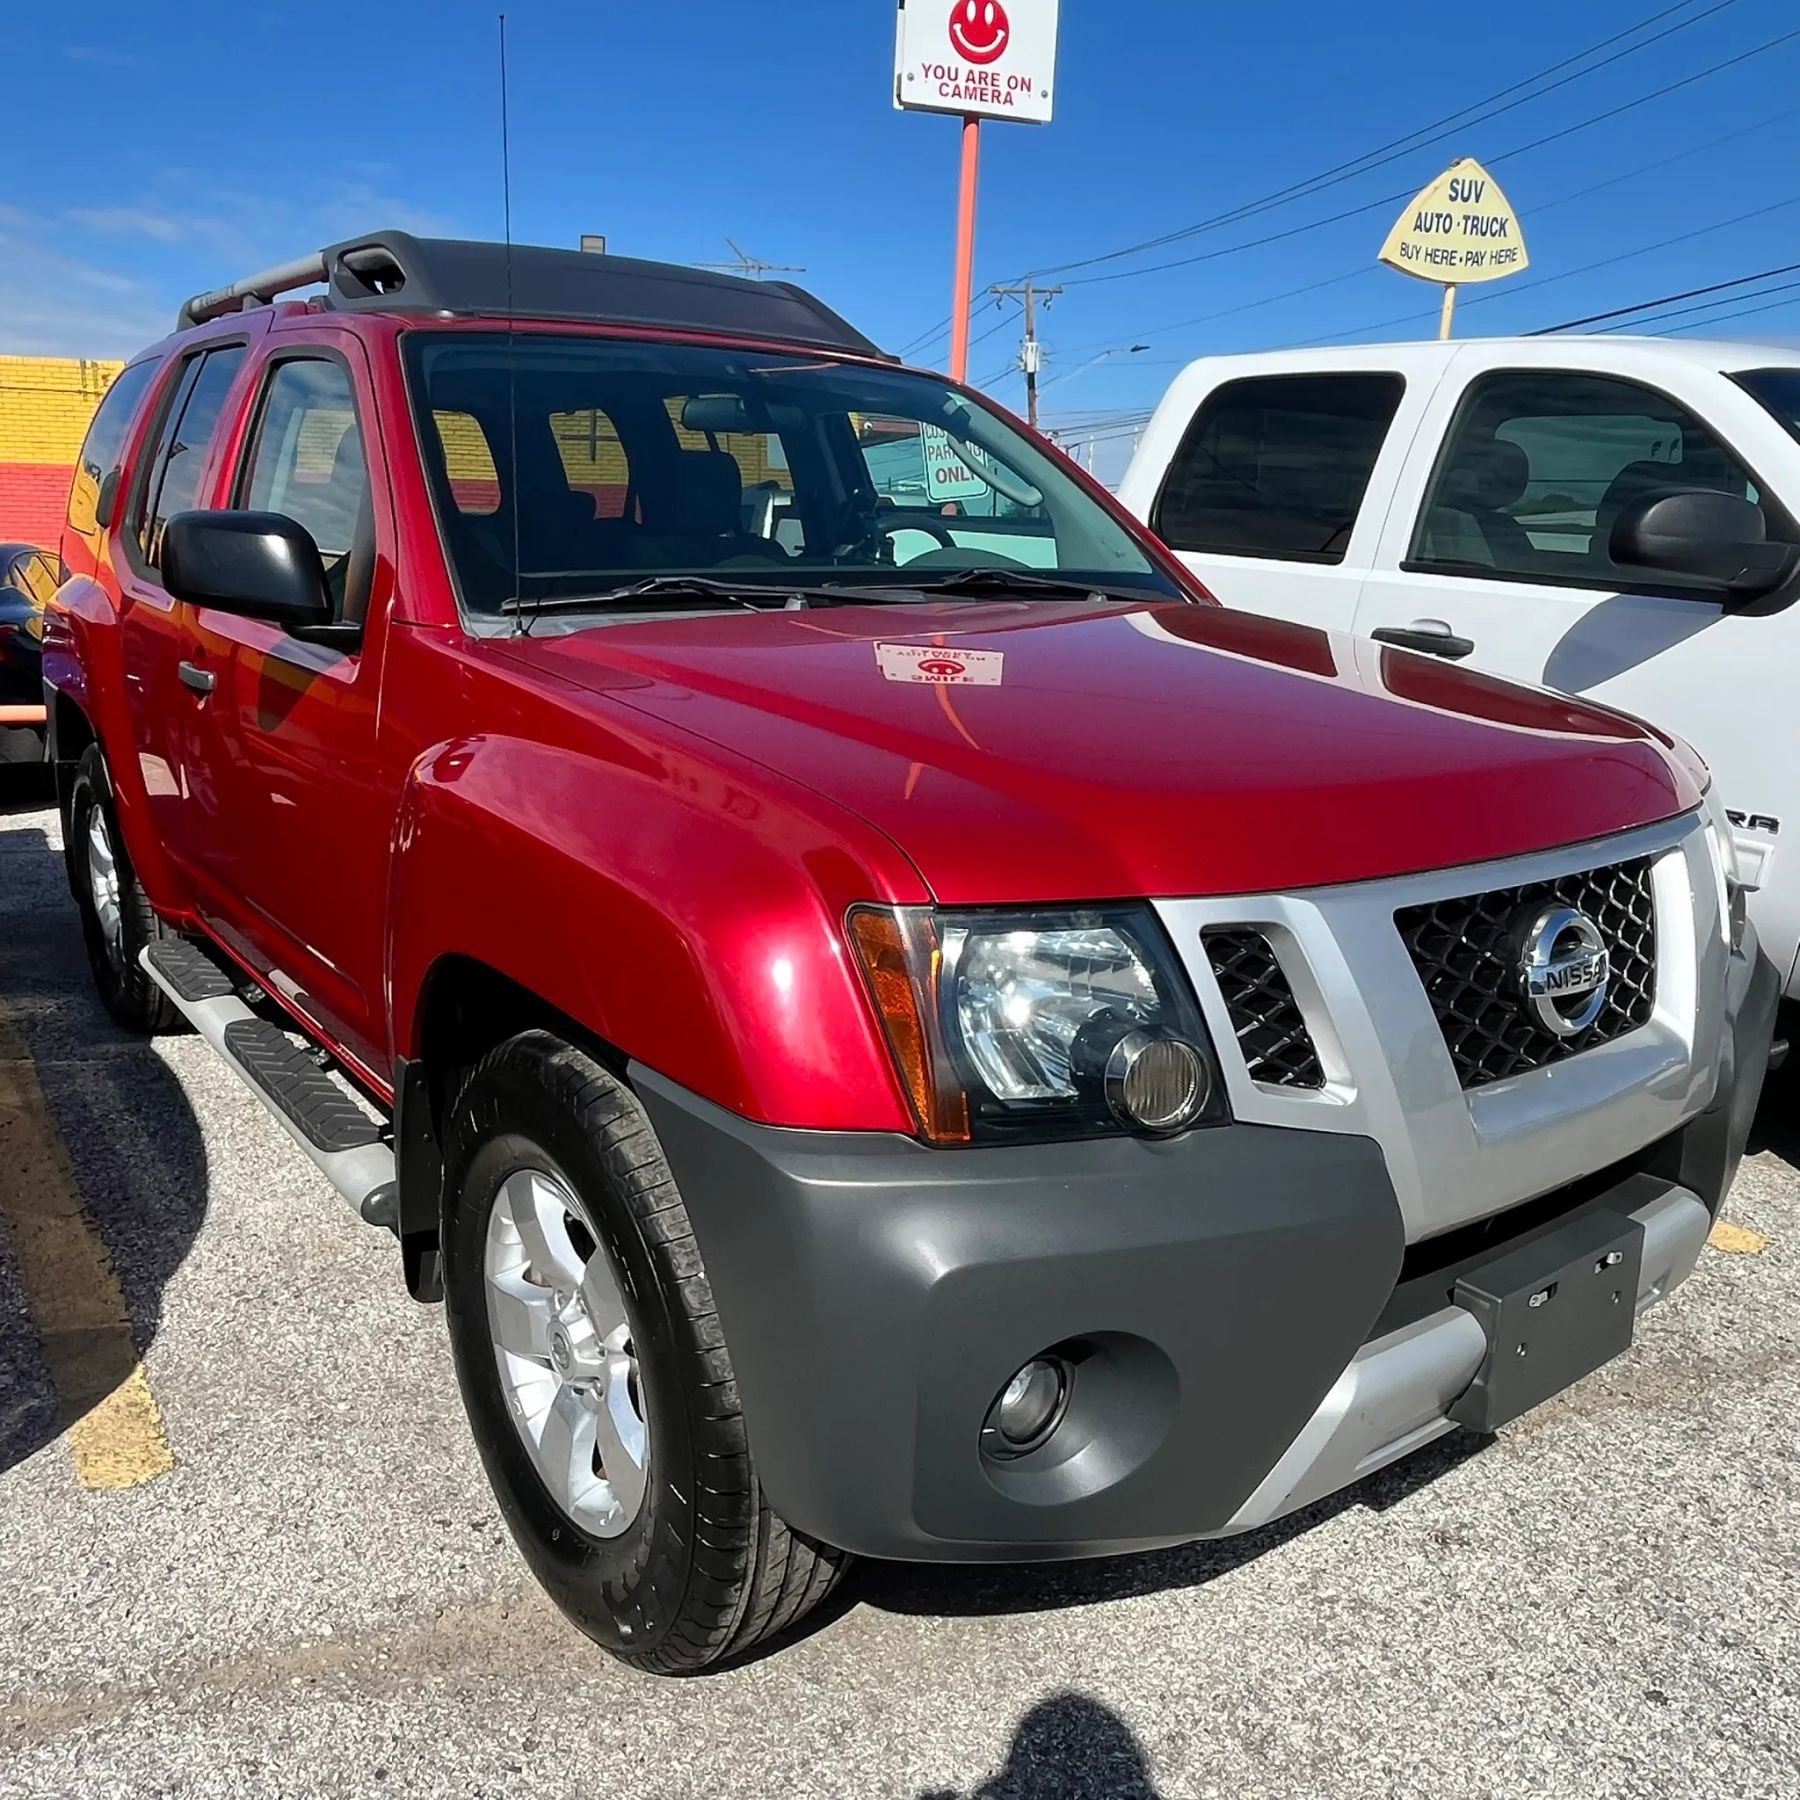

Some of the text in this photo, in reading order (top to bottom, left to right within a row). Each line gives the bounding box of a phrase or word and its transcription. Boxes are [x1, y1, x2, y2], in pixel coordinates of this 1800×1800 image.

[921, 63, 1032, 92] YOU ARE ON
[938, 82, 1014, 106] CAMERA
[1449, 178, 1485, 203] SUV
[1413, 211, 1509, 237] AUTO TRUCK
[1400, 242, 1518, 267] BUY HERE PAY HERE
